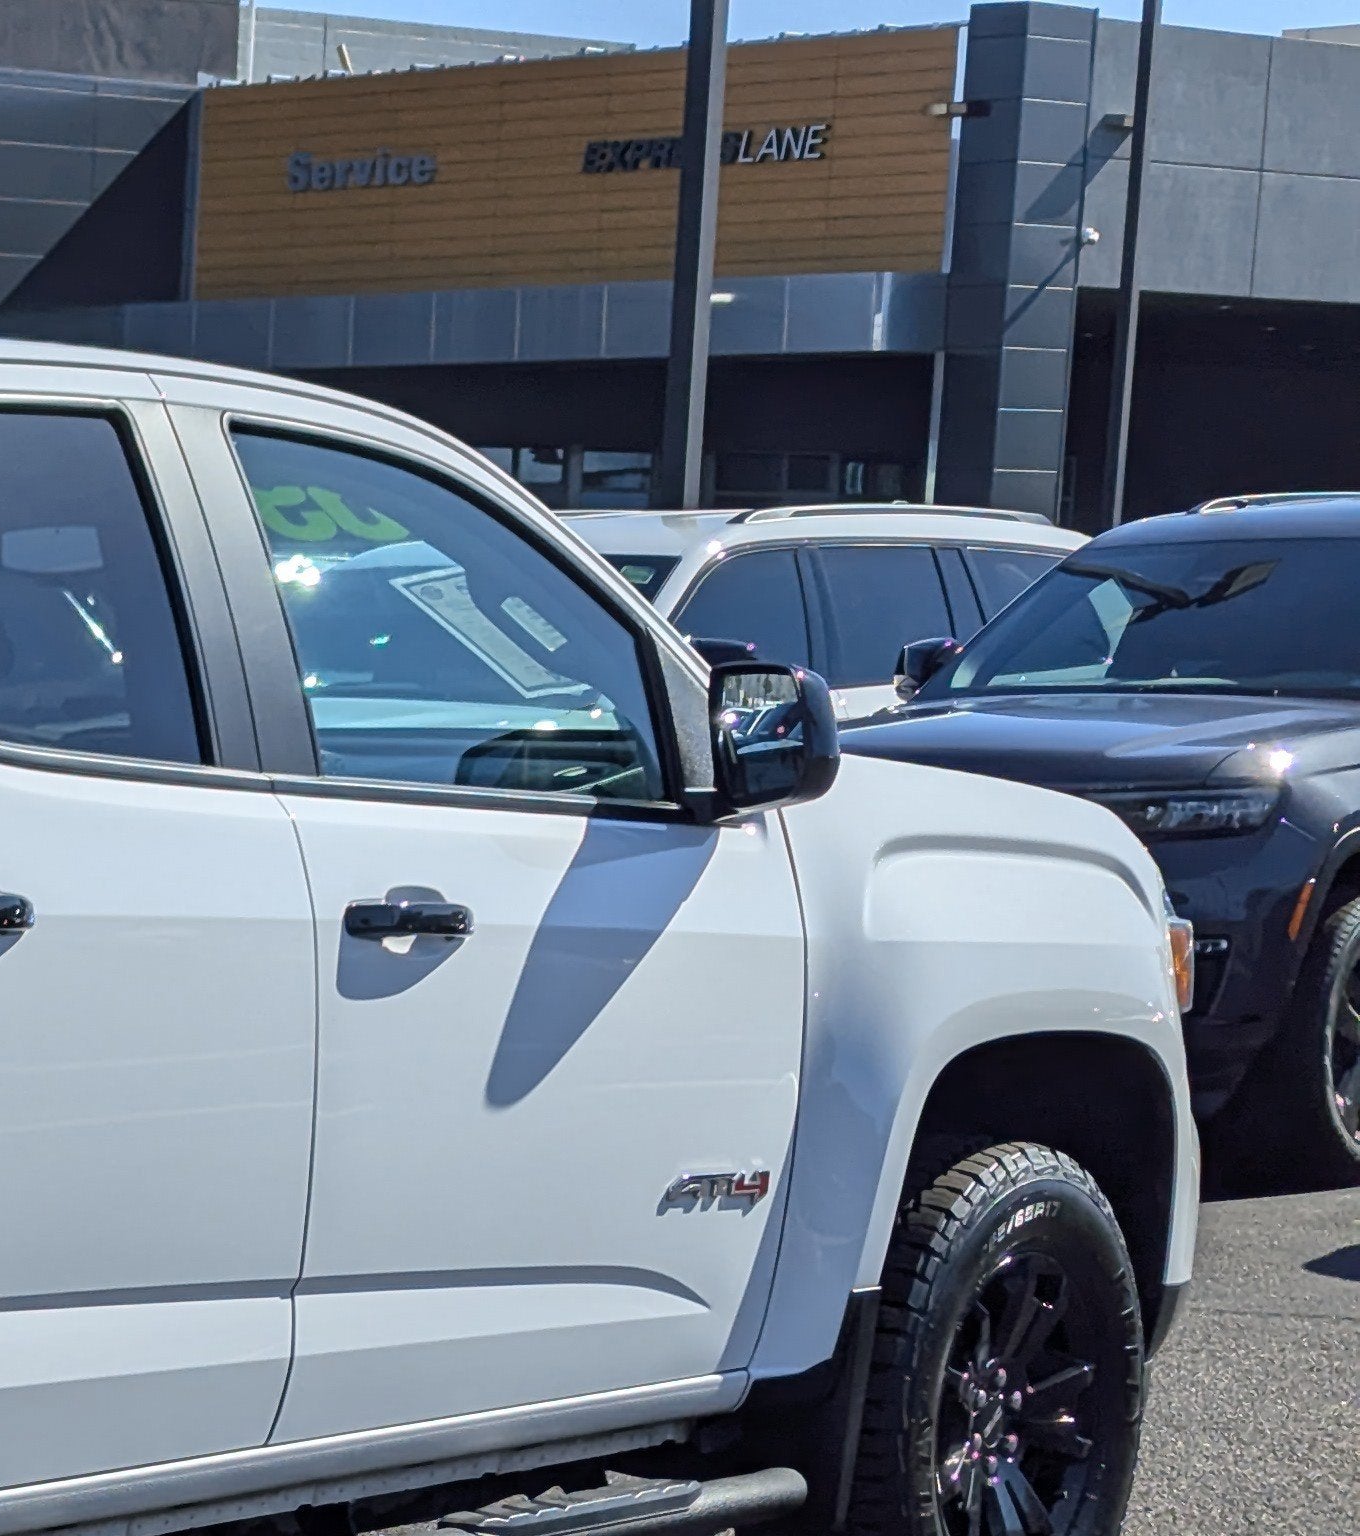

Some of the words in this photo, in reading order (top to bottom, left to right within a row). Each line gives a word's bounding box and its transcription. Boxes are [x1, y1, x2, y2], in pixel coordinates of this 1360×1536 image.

[737, 122, 831, 164] LANE
[287, 148, 437, 193] Service
[660, 1169, 771, 1208] AT4
